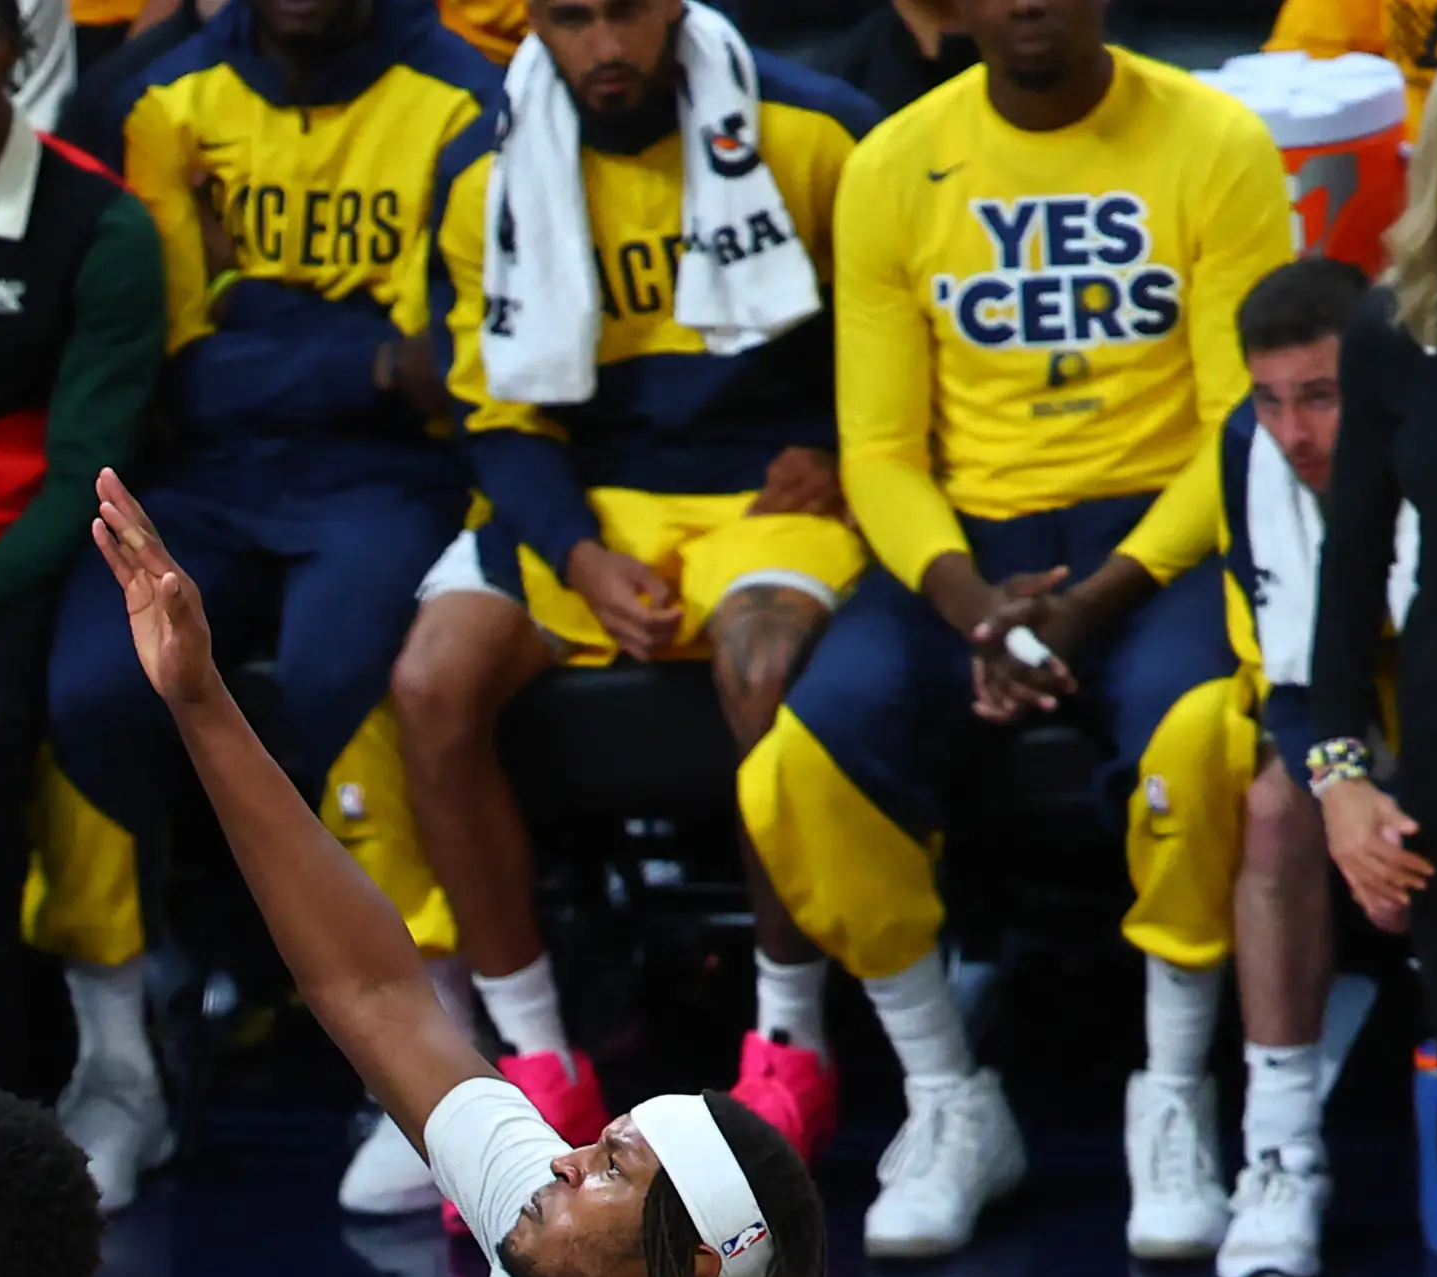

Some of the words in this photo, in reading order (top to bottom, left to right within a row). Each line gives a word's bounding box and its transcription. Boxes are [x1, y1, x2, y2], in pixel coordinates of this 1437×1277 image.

[226, 183, 402, 267] CERS
[972, 193, 1148, 271] YES
[934, 268, 1182, 346] 'CERS
